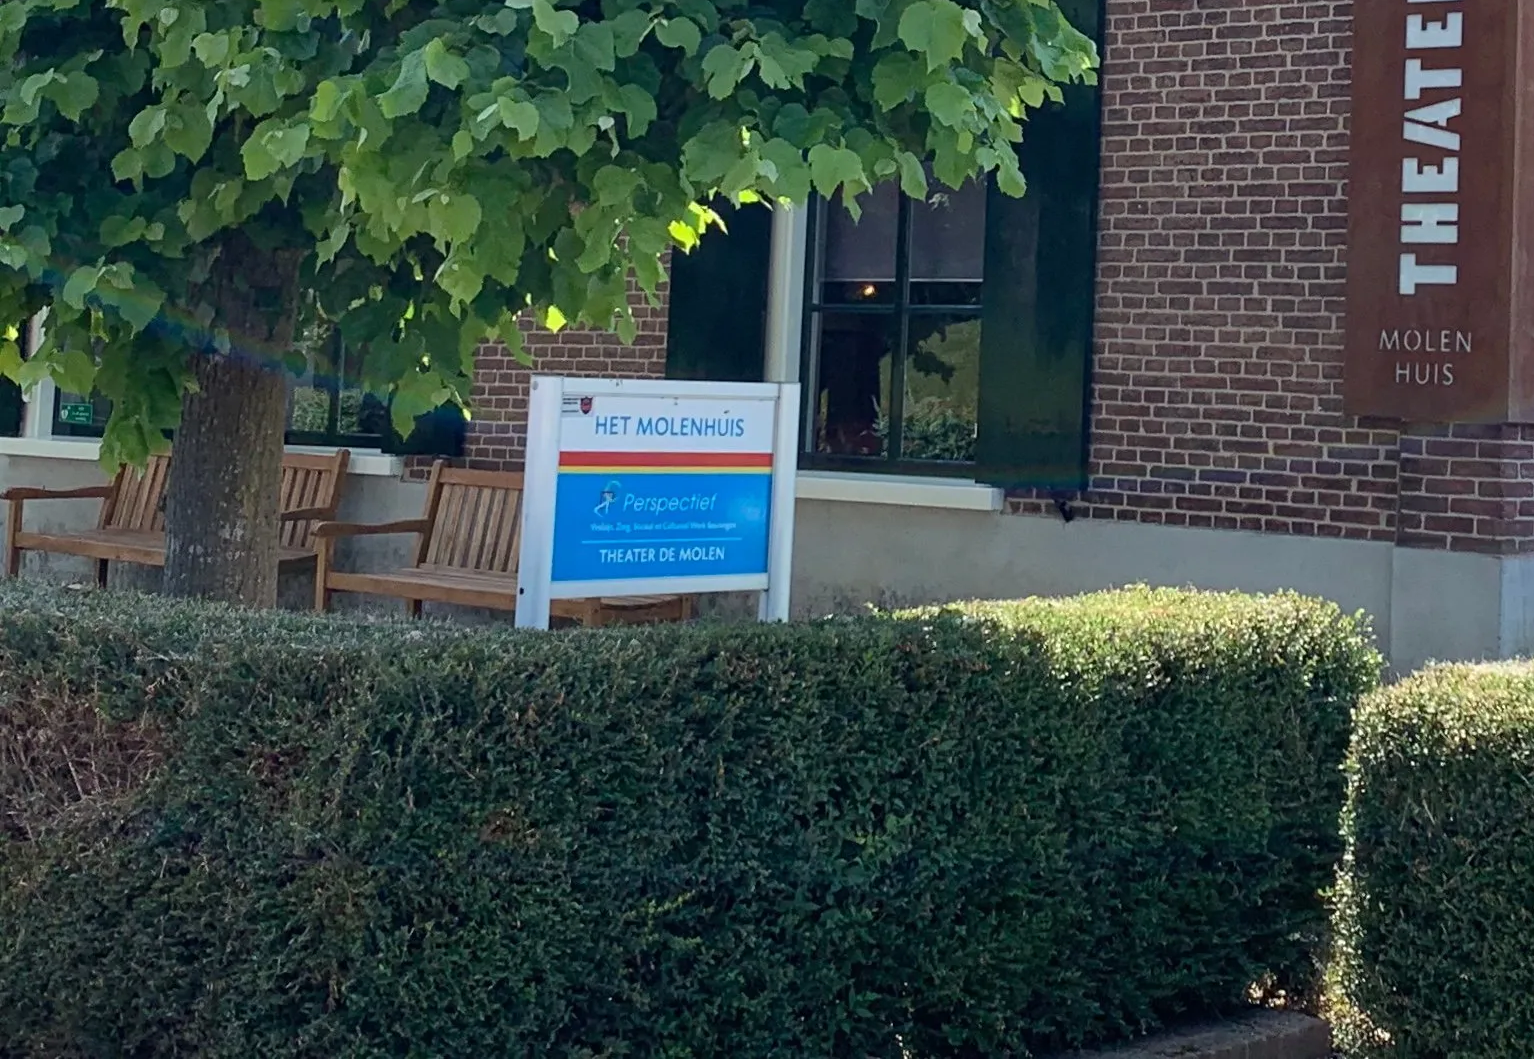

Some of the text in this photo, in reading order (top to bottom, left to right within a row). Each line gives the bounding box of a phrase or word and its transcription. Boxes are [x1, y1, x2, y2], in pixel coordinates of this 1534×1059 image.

[1379, 328, 1472, 353] MOLEN
[1395, 361, 1455, 386] HUIS
[595, 415, 745, 437] HET MOLENHUIS
[623, 493, 718, 516] Perspectief
[599, 546, 725, 563] THEATER DE MOLEN
